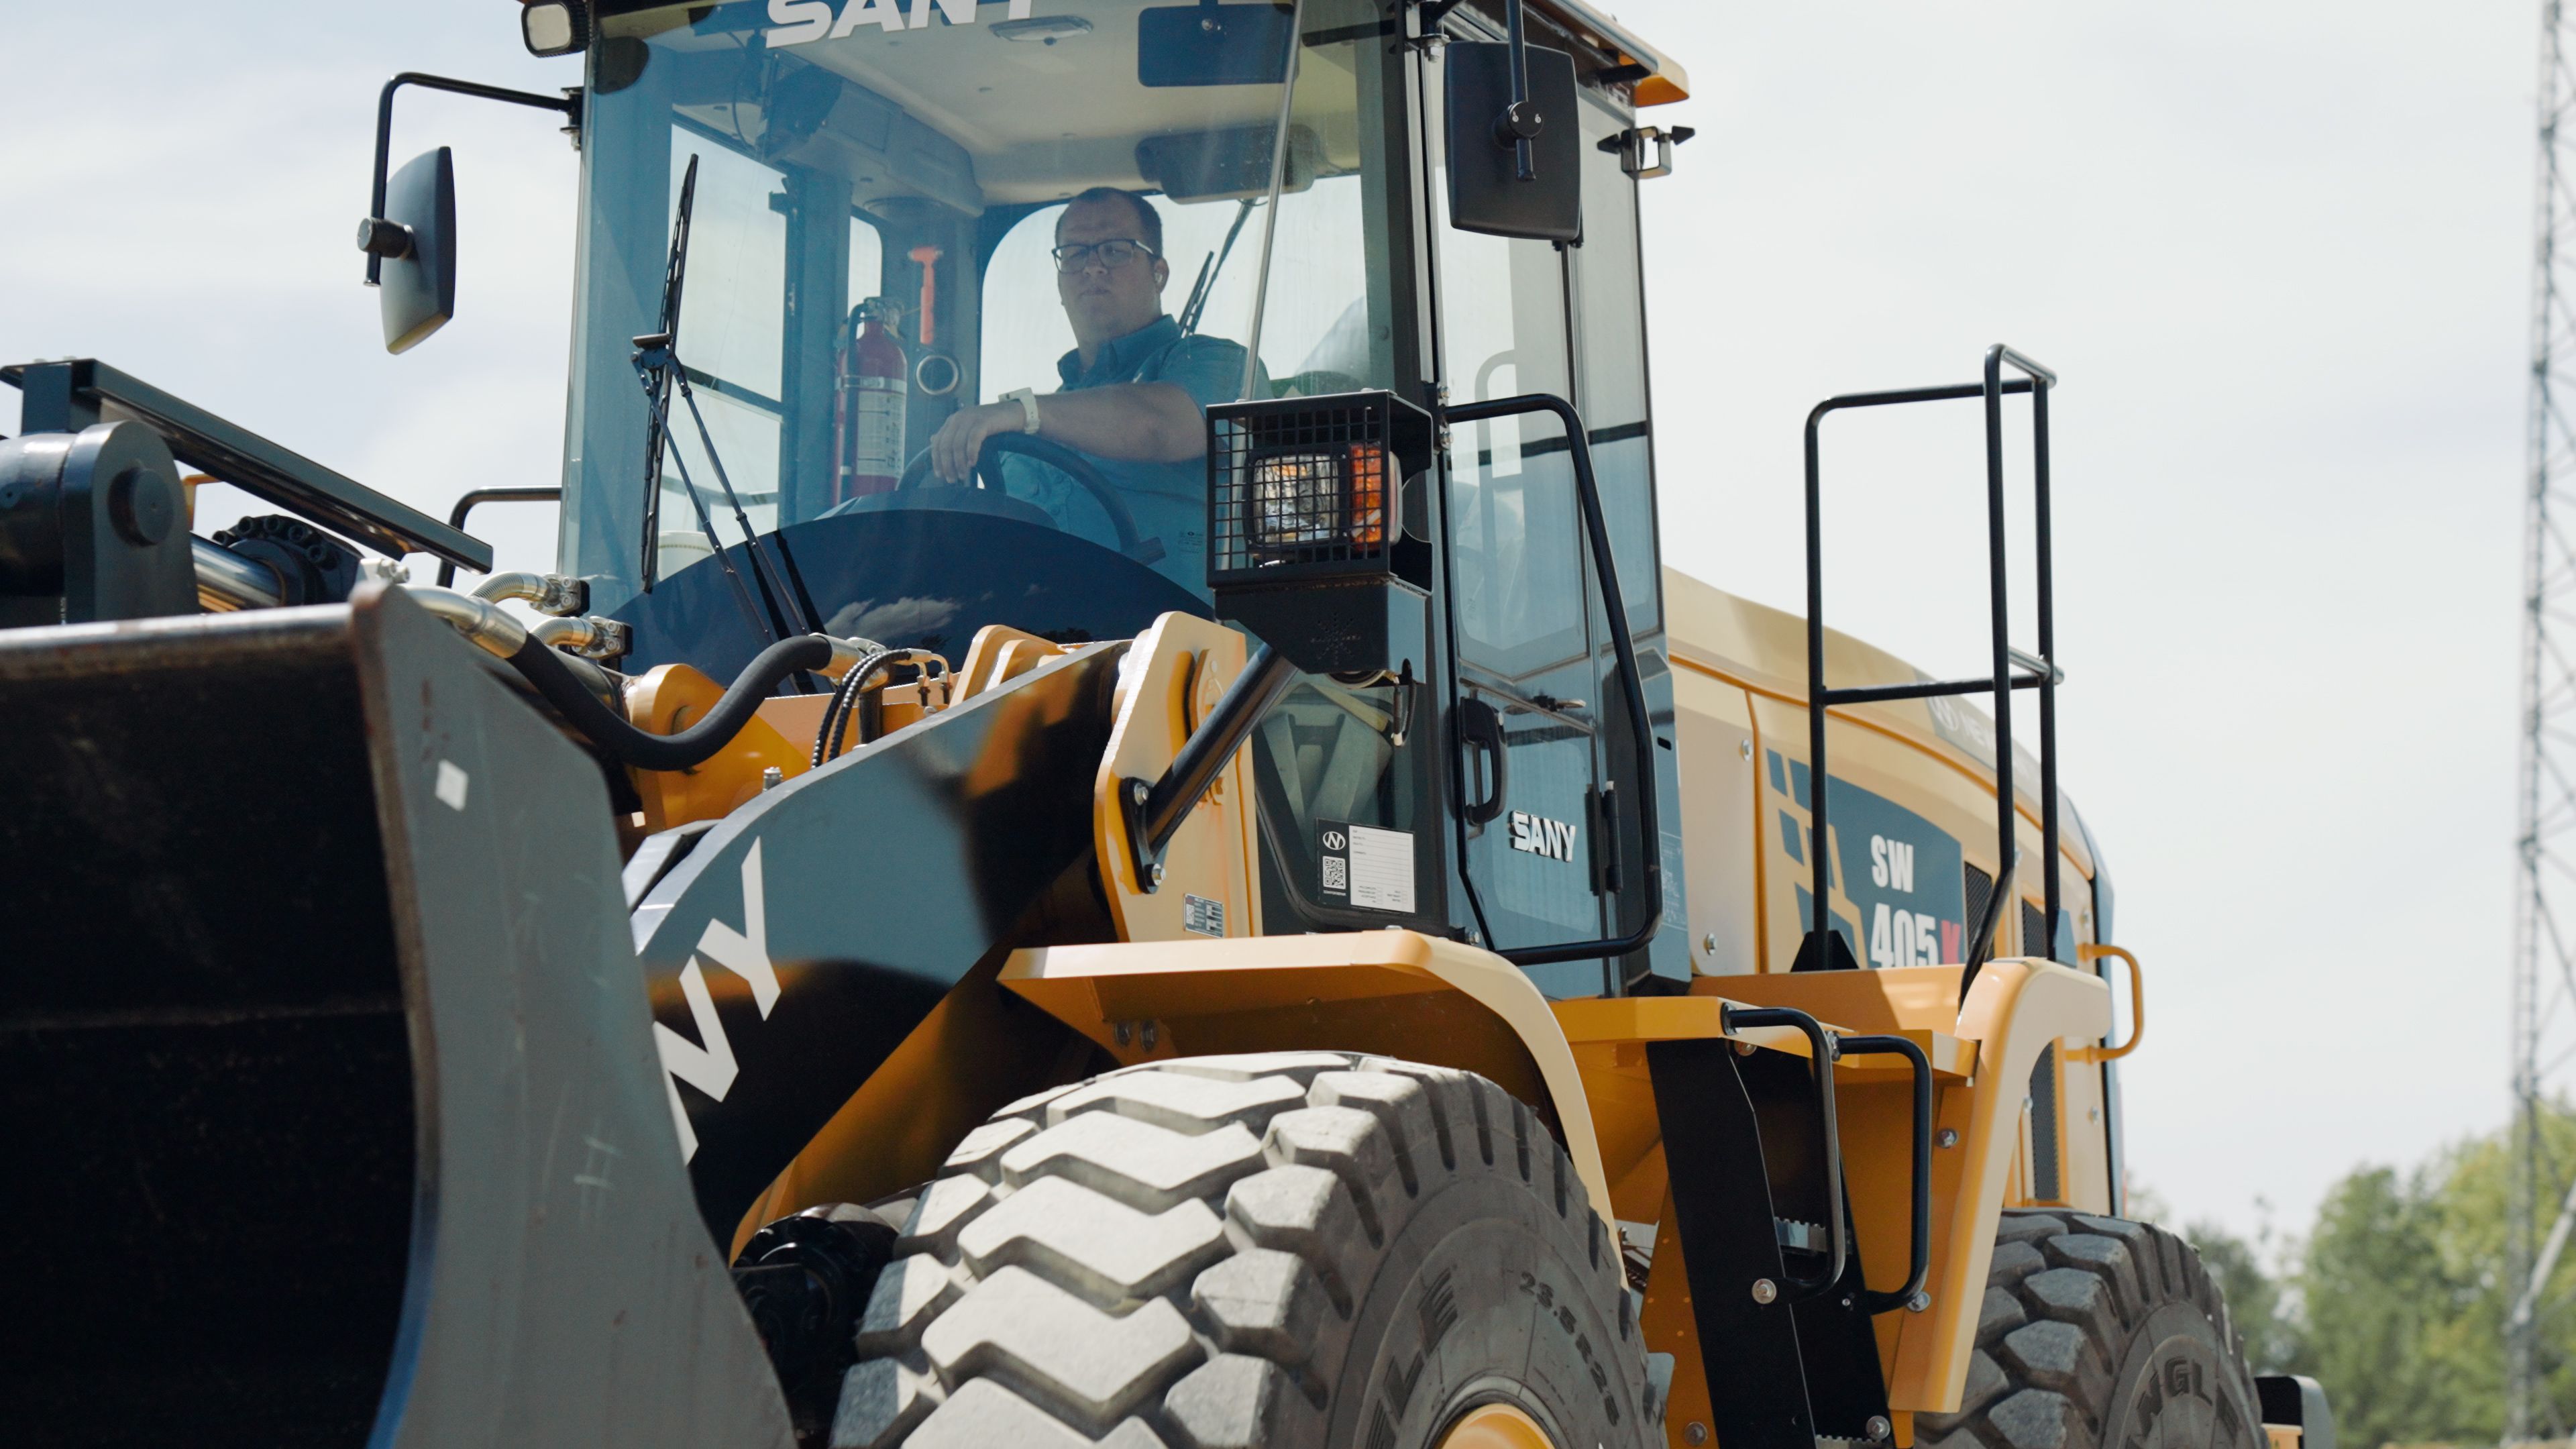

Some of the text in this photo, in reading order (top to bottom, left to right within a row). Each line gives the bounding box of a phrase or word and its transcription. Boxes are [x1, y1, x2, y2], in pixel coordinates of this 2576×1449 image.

[765, 0, 1032, 48] SAN
[1509, 810, 1576, 862] SANY
[1870, 835, 1914, 893] SW
